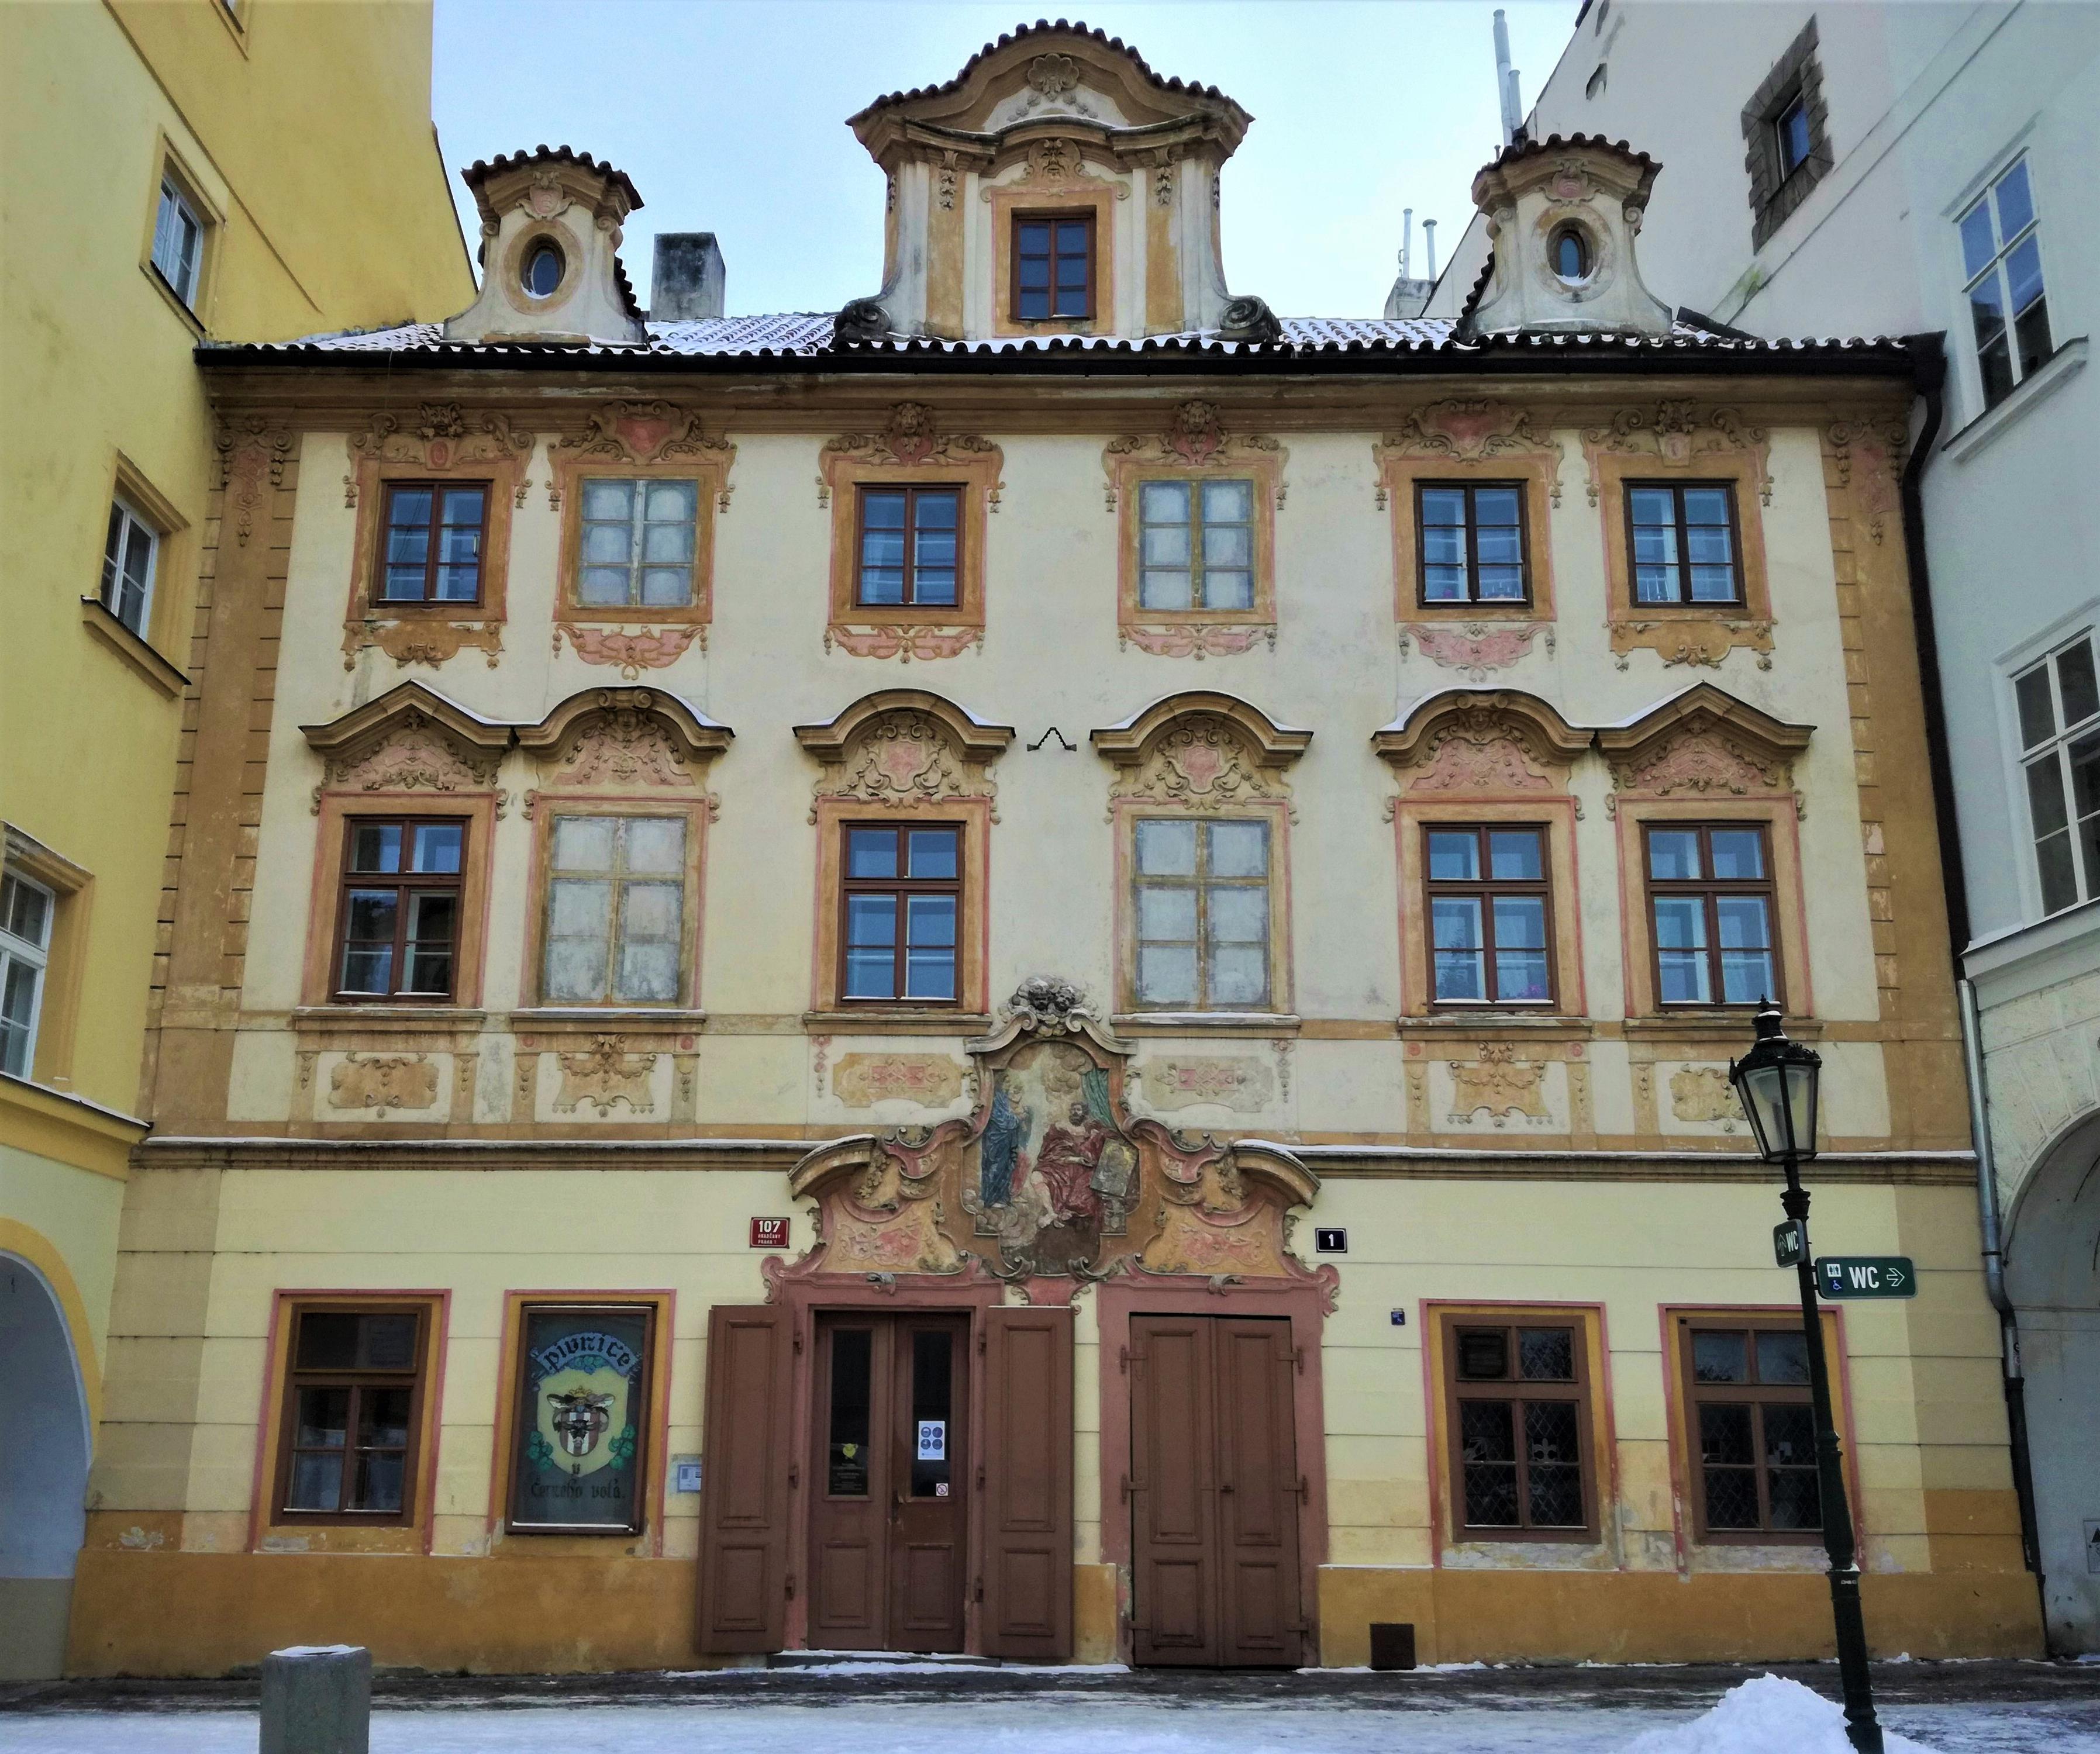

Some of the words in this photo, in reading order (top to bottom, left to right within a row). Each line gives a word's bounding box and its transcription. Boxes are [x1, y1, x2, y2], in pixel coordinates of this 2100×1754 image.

[759, 1220, 781, 1232] 107
[1329, 1234, 1334, 1247] 1
[1786, 1230, 1799, 1252] WC
[1849, 1266, 1880, 1289] WC
